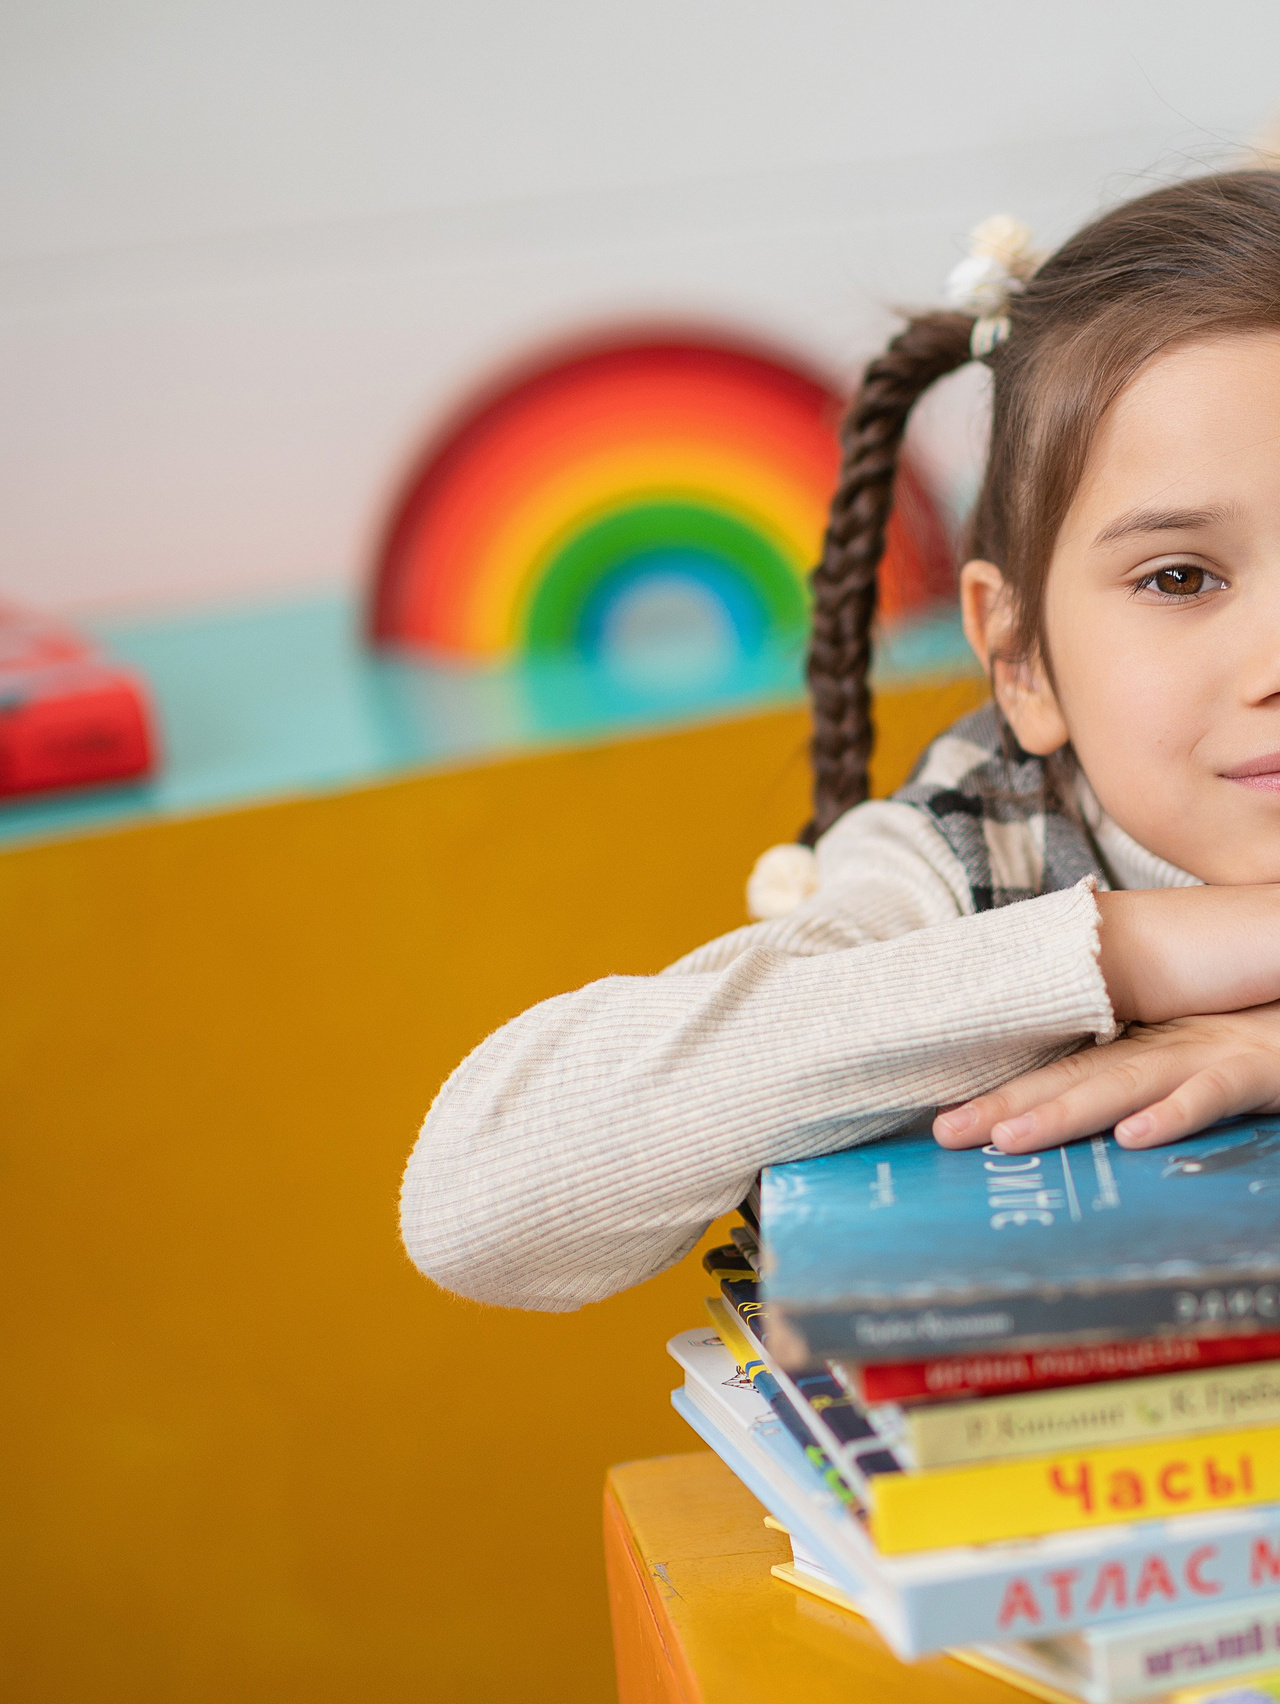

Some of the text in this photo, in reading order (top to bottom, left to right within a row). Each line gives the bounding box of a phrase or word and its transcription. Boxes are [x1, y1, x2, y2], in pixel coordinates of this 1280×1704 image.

[981, 1144, 1065, 1230] ЭДИС
[1047, 1456, 1253, 1514] Часы
[996, 1544, 1224, 1630] АТЛАС
